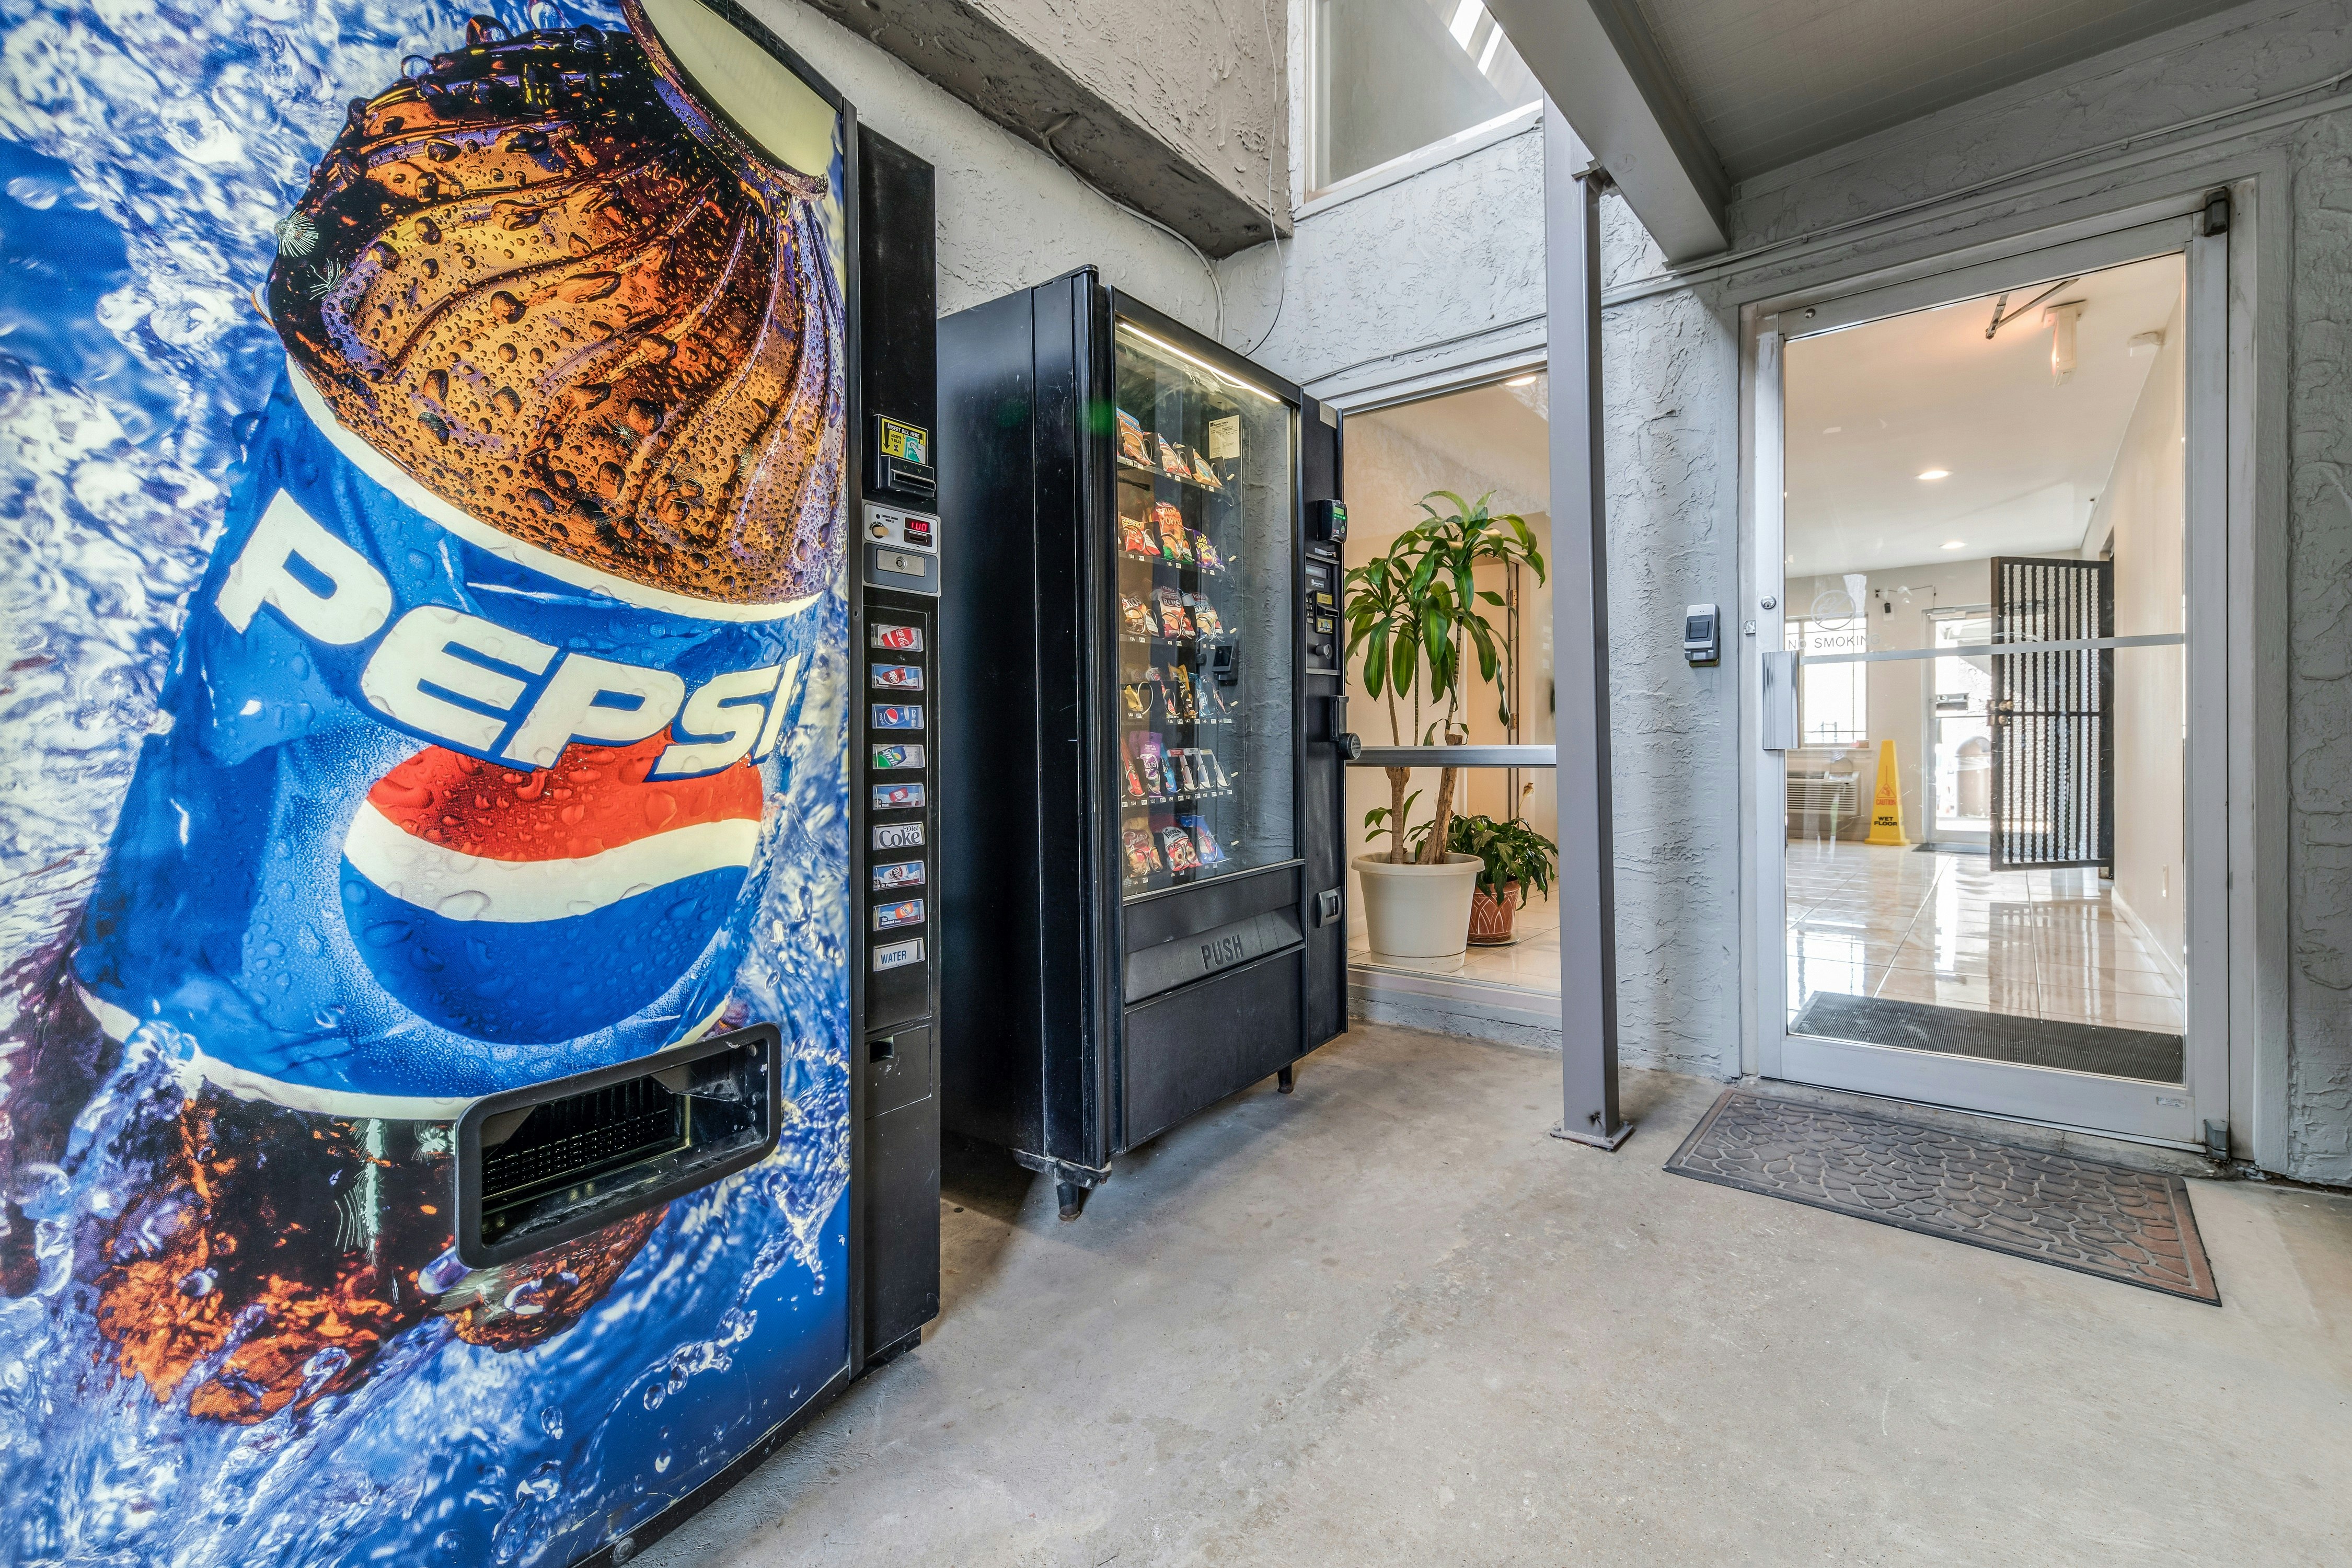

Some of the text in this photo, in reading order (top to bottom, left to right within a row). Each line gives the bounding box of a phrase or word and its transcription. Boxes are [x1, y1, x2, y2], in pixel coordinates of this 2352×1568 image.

[887, 422, 901, 431] INSERT
[215, 487, 801, 776] PEPSI
[1788, 638, 1807, 650] NO
[1814, 633, 1880, 649] SMOKING
[879, 829, 920, 847] Coke
[881, 950, 907, 964] WATER
[1201, 934, 1244, 970] PUSH
